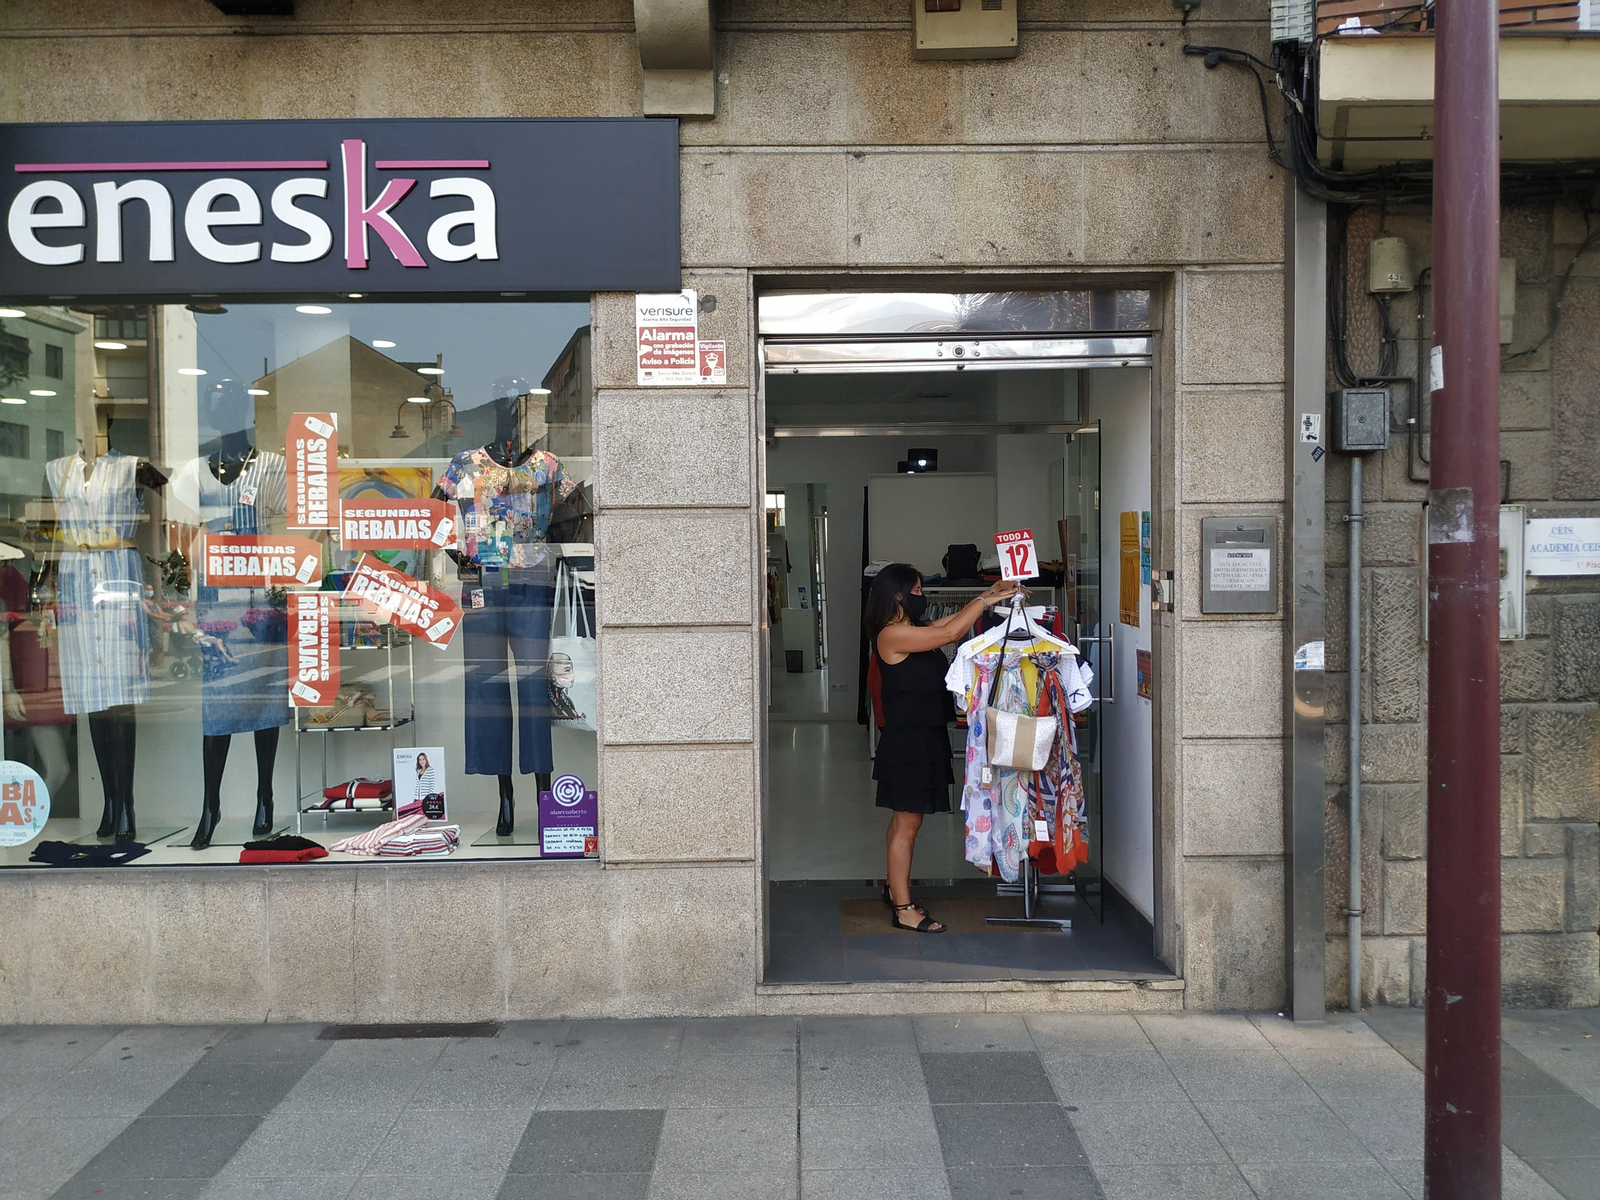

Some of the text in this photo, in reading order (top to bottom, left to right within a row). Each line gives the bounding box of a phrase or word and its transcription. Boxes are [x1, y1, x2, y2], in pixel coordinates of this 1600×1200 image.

[8, 138, 499, 268] eneska
[640, 307, 693, 316] verisure
[640, 328, 694, 341] Alarma
[665, 342, 694, 350] grabación
[296, 438, 306, 525] SEGUNDAS
[307, 438, 328, 525] REBAJAS
[345, 509, 431, 518] SEGUNDAS
[345, 519, 432, 540] REBAJAS
[997, 531, 1030, 542] TODO A
[1551, 527, 1574, 535] CEIS
[209, 545, 296, 554] SEGUNDAS
[1530, 543, 1580, 553] ACADEMIA
[209, 556, 296, 576] REBAJAS
[1005, 543, 1032, 577] 12
[361, 564, 440, 611] SEGUNDAS
[352, 575, 434, 629] REBAJAS
[299, 596, 318, 682] REBAJAS
[320, 596, 329, 682] SEGUNDAS
